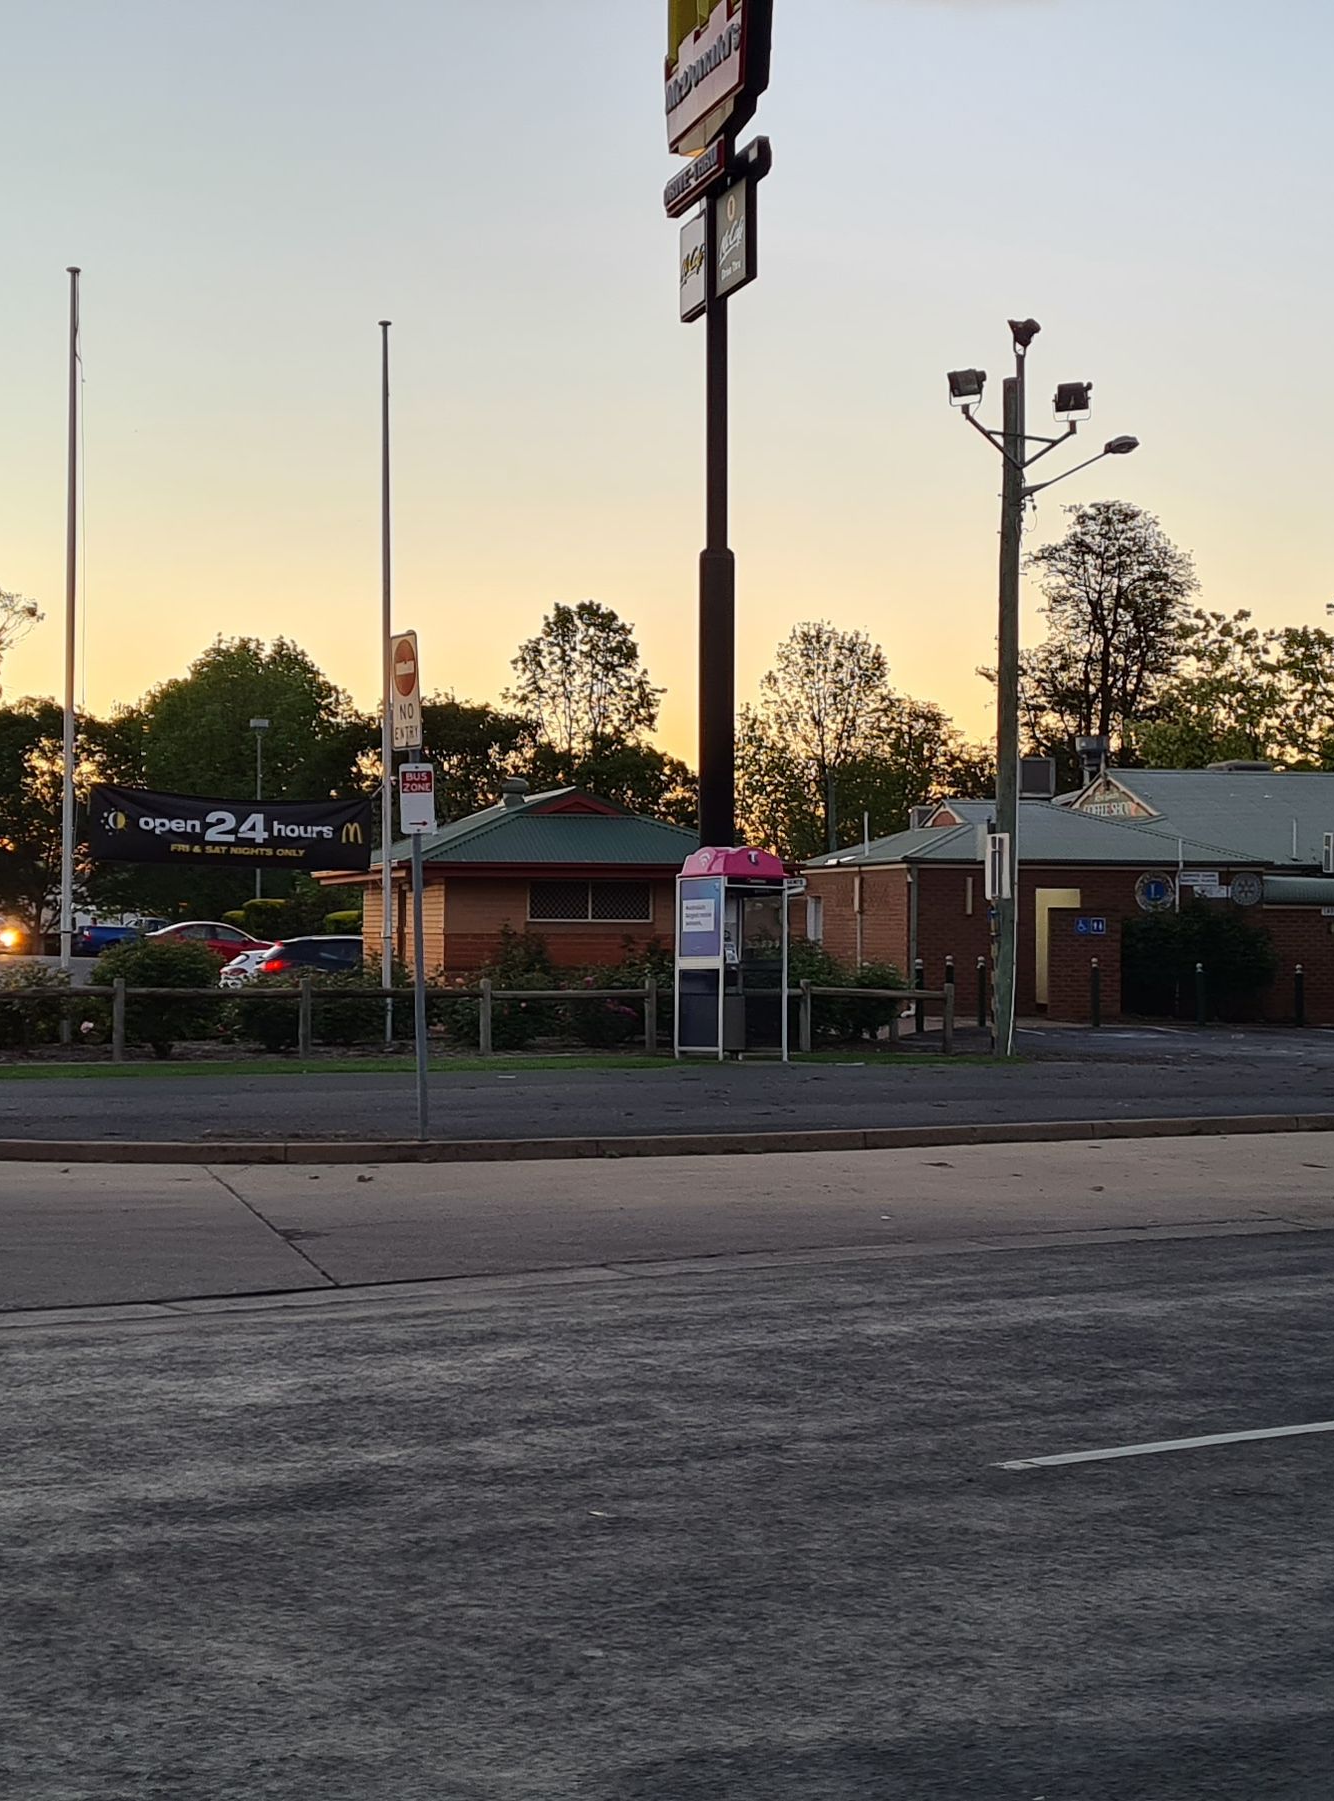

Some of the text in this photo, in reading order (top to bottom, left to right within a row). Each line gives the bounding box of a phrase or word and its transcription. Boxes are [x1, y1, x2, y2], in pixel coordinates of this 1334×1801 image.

[399, 703, 414, 720] NO
[395, 725, 419, 741] ENTRY
[405, 772, 428, 781] BUS
[403, 783, 431, 792] ZONE
[138, 815, 201, 835] open
[204, 810, 269, 844] 24
[273, 820, 334, 839] hours
[170, 843, 306, 857] FRI & SAT NIGHTS ONLY
